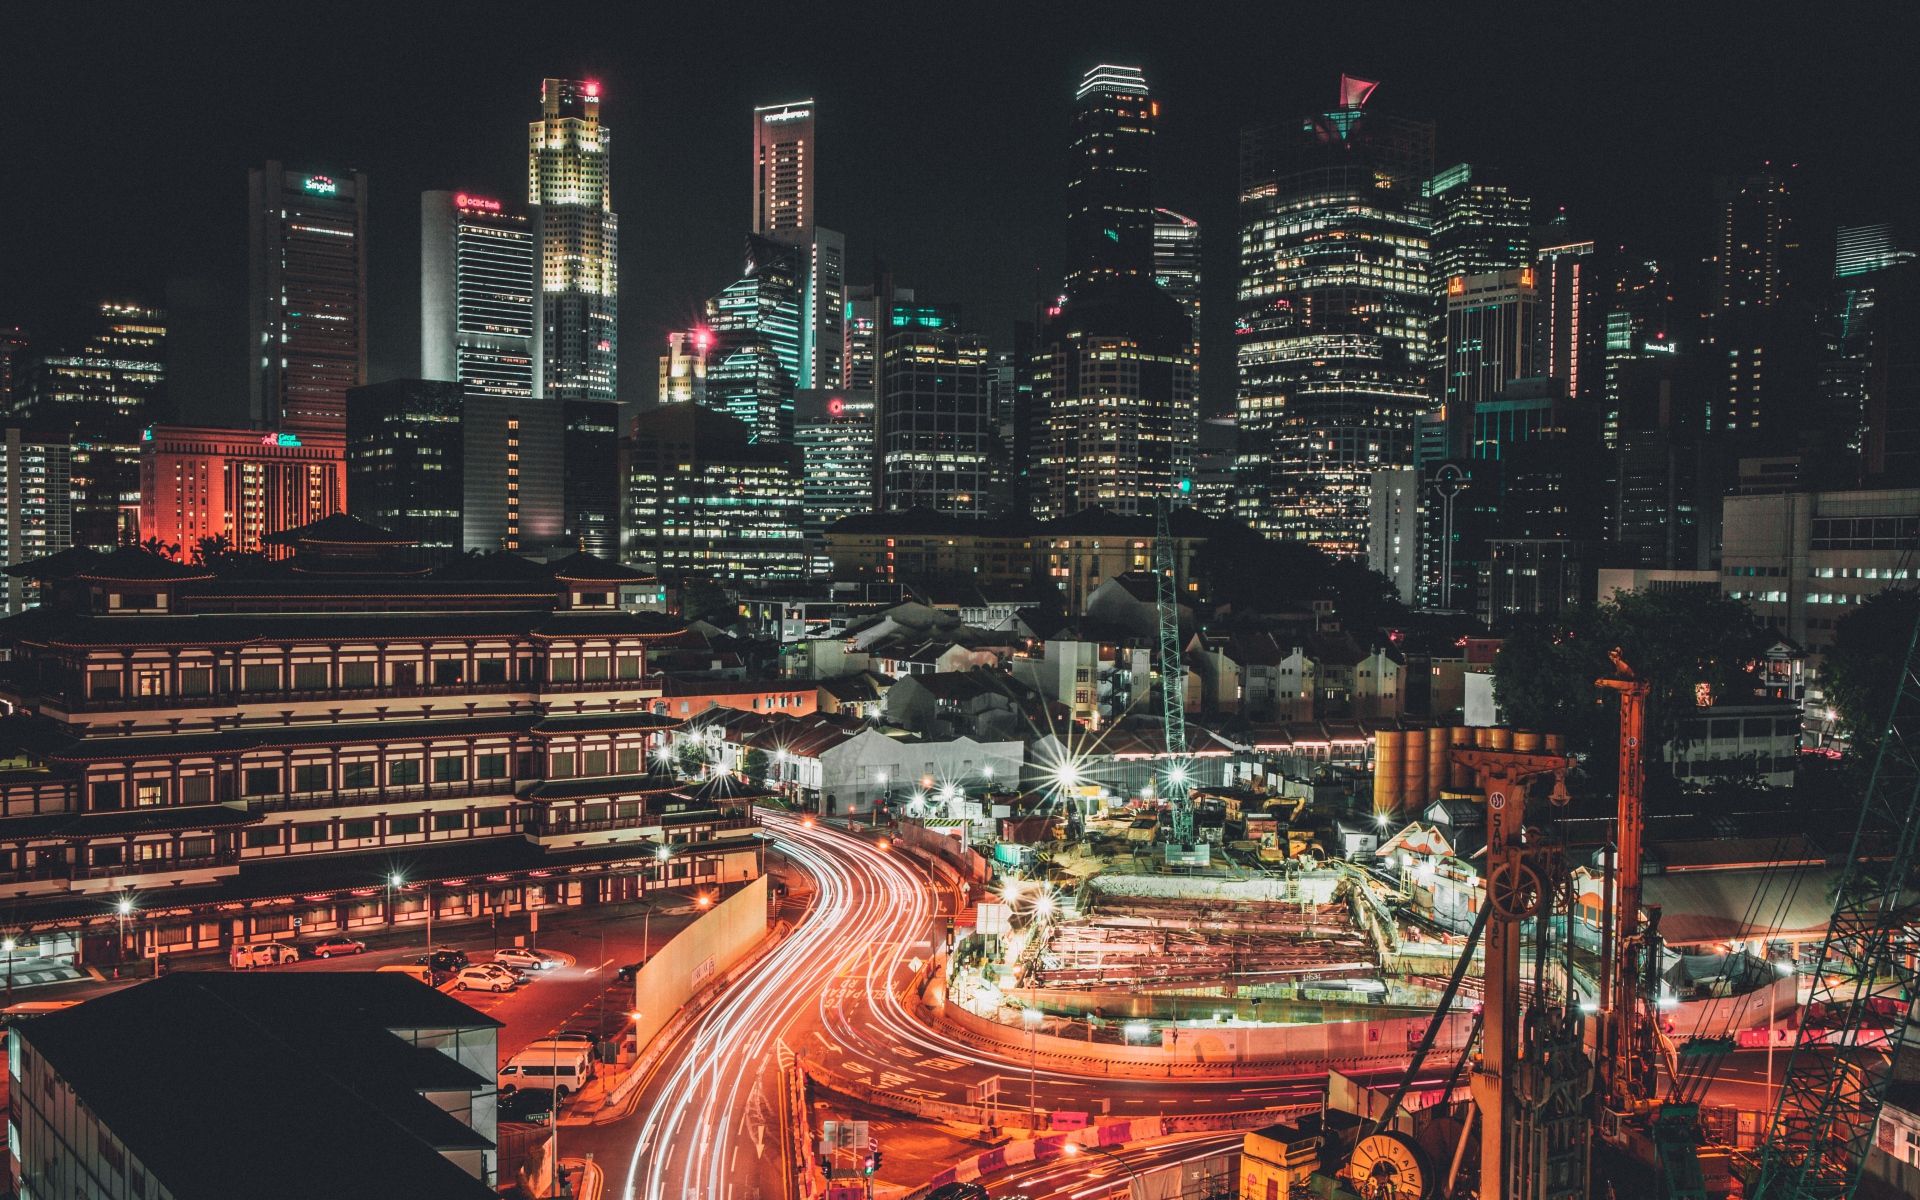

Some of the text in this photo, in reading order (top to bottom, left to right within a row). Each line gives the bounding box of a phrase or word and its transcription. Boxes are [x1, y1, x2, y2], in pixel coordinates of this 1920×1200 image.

[584, 95, 599, 103] UOB
[305, 180, 335, 193] Singtel
[278, 433, 295, 441] Great
[841, 980, 858, 988] RD
